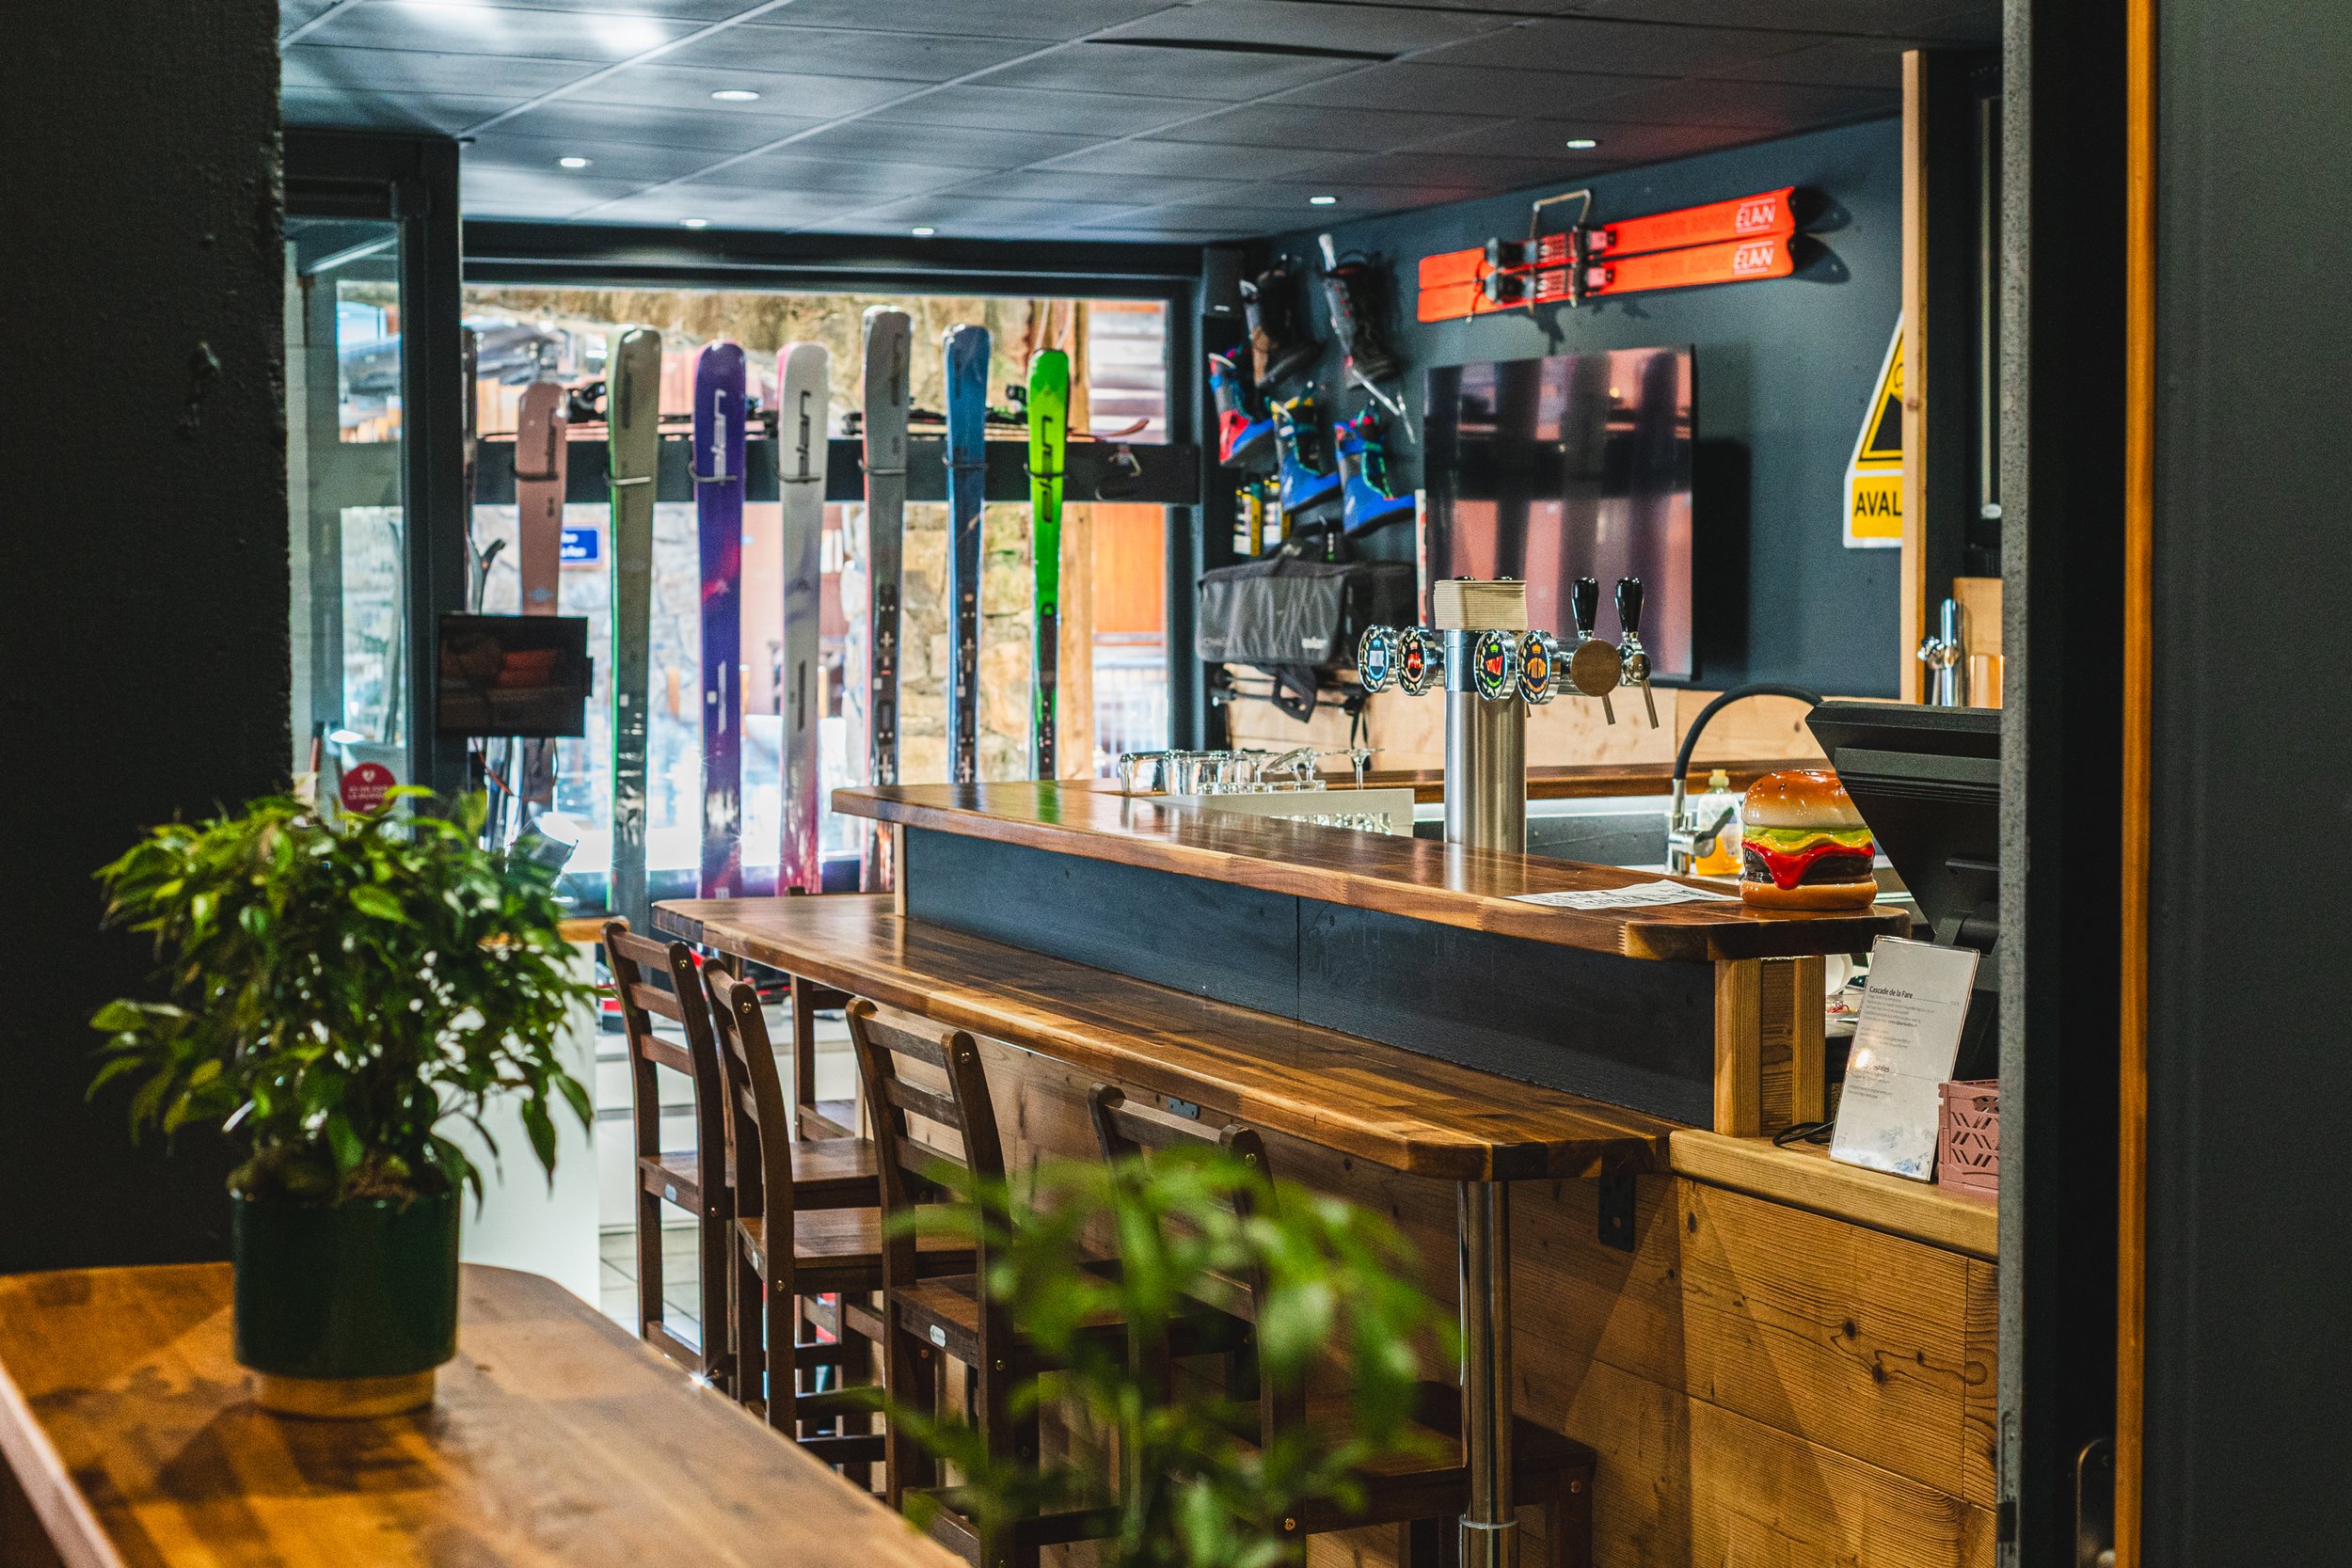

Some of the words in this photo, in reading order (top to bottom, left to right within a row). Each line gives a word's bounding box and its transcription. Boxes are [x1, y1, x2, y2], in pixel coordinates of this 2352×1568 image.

[1736, 204, 1776, 229] ELAN
[1734, 246, 1774, 271] ELAN
[1868, 985, 1889, 995] Cascade
